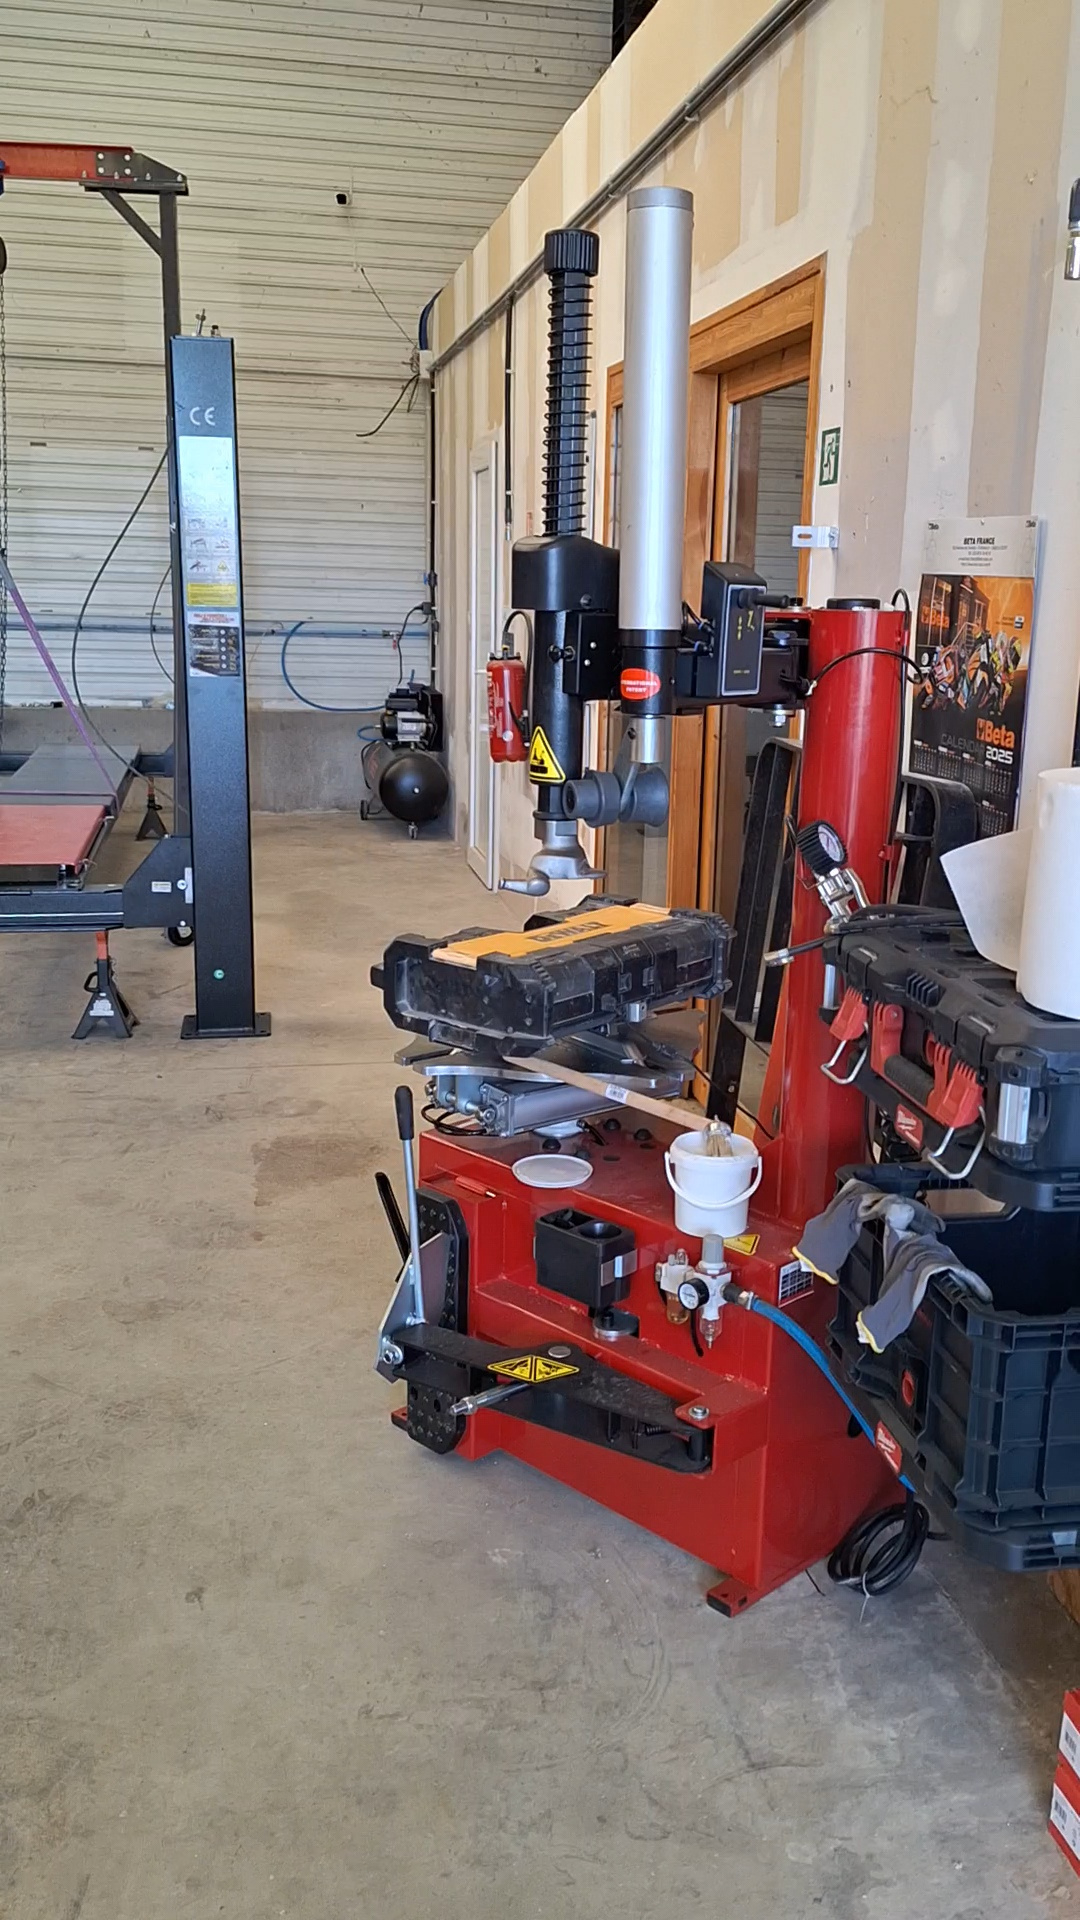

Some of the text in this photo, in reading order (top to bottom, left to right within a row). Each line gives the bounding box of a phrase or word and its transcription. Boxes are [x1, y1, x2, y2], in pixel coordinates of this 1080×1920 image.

[190, 407, 216, 426] CE
[963, 537, 996, 545] BETA FRANCE
[985, 719, 1015, 748] Beta
[985, 745, 1014, 765] 2025
